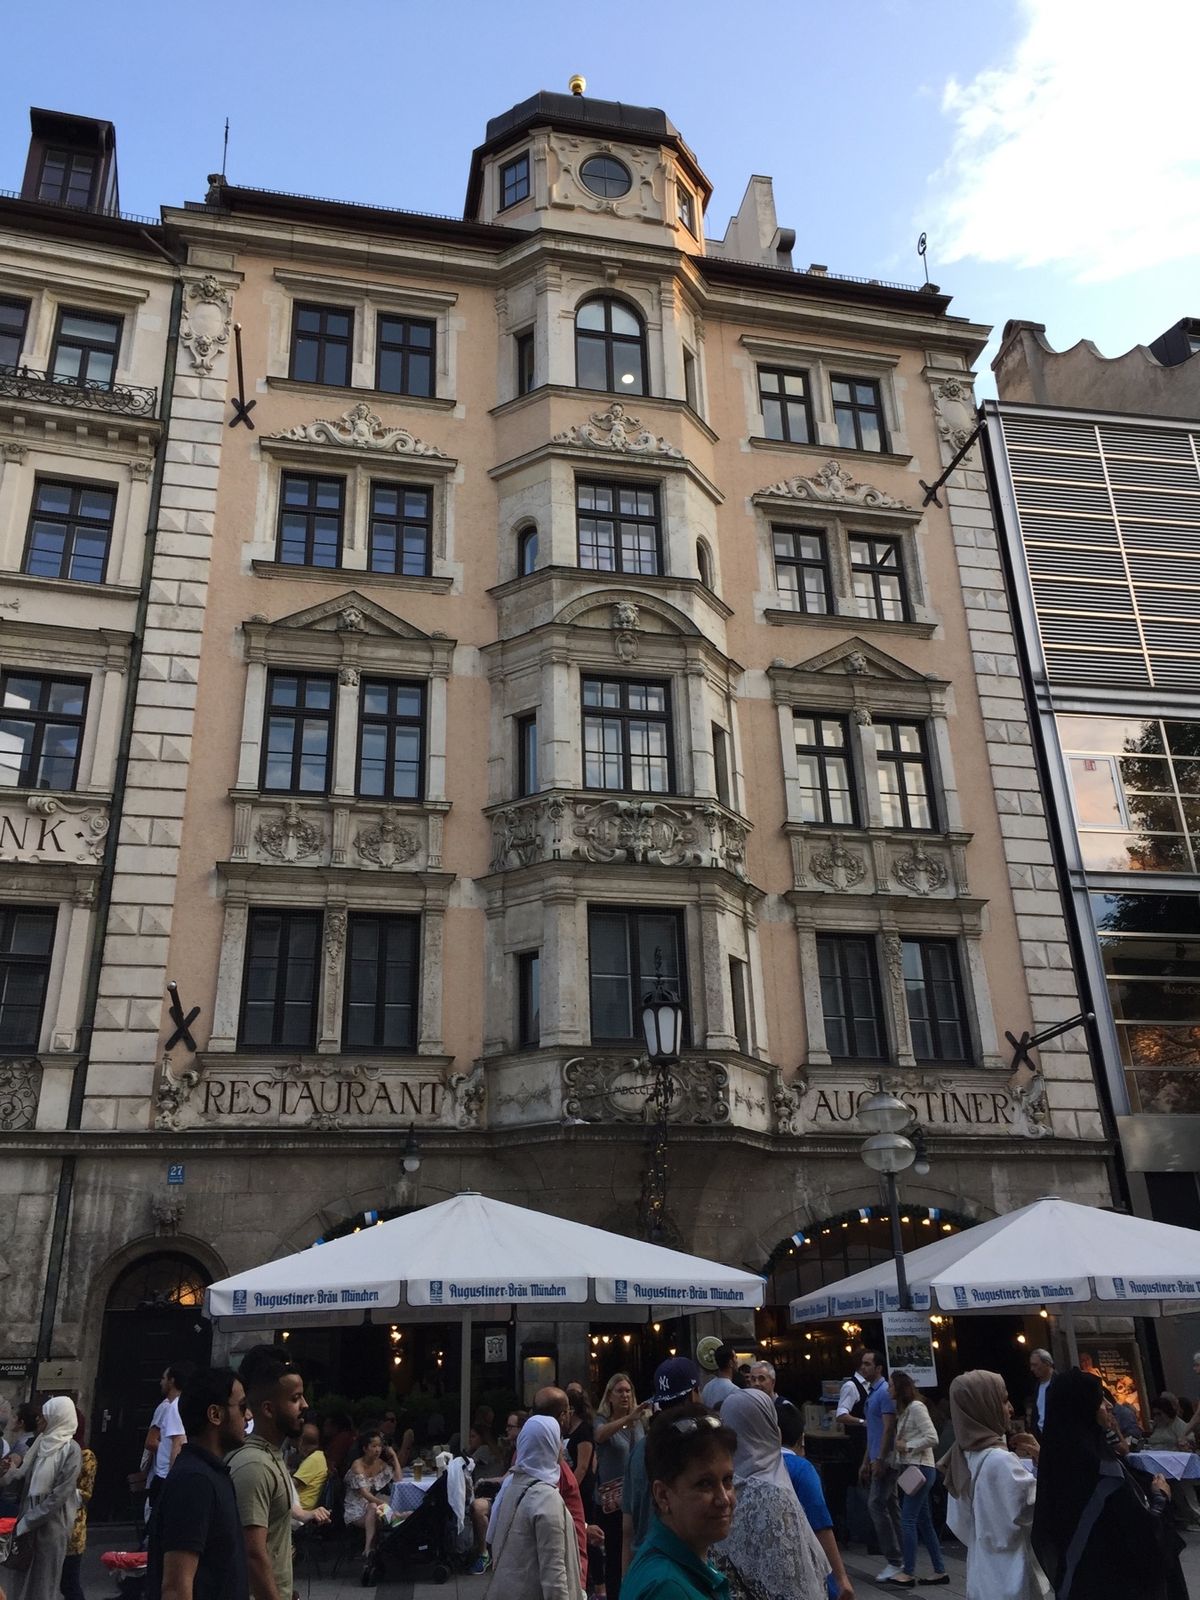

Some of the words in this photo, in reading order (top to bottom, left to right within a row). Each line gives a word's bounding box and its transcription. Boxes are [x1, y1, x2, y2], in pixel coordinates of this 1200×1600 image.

[201, 1080, 447, 1115] RESTAURANT
[810, 1089, 1014, 1125] AUSTINER
[170, 1165, 183, 1176] 27
[341, 1289, 379, 1303] München
[530, 1284, 567, 1297] München
[710, 1287, 744, 1301] München
[1041, 1284, 1074, 1298] München
